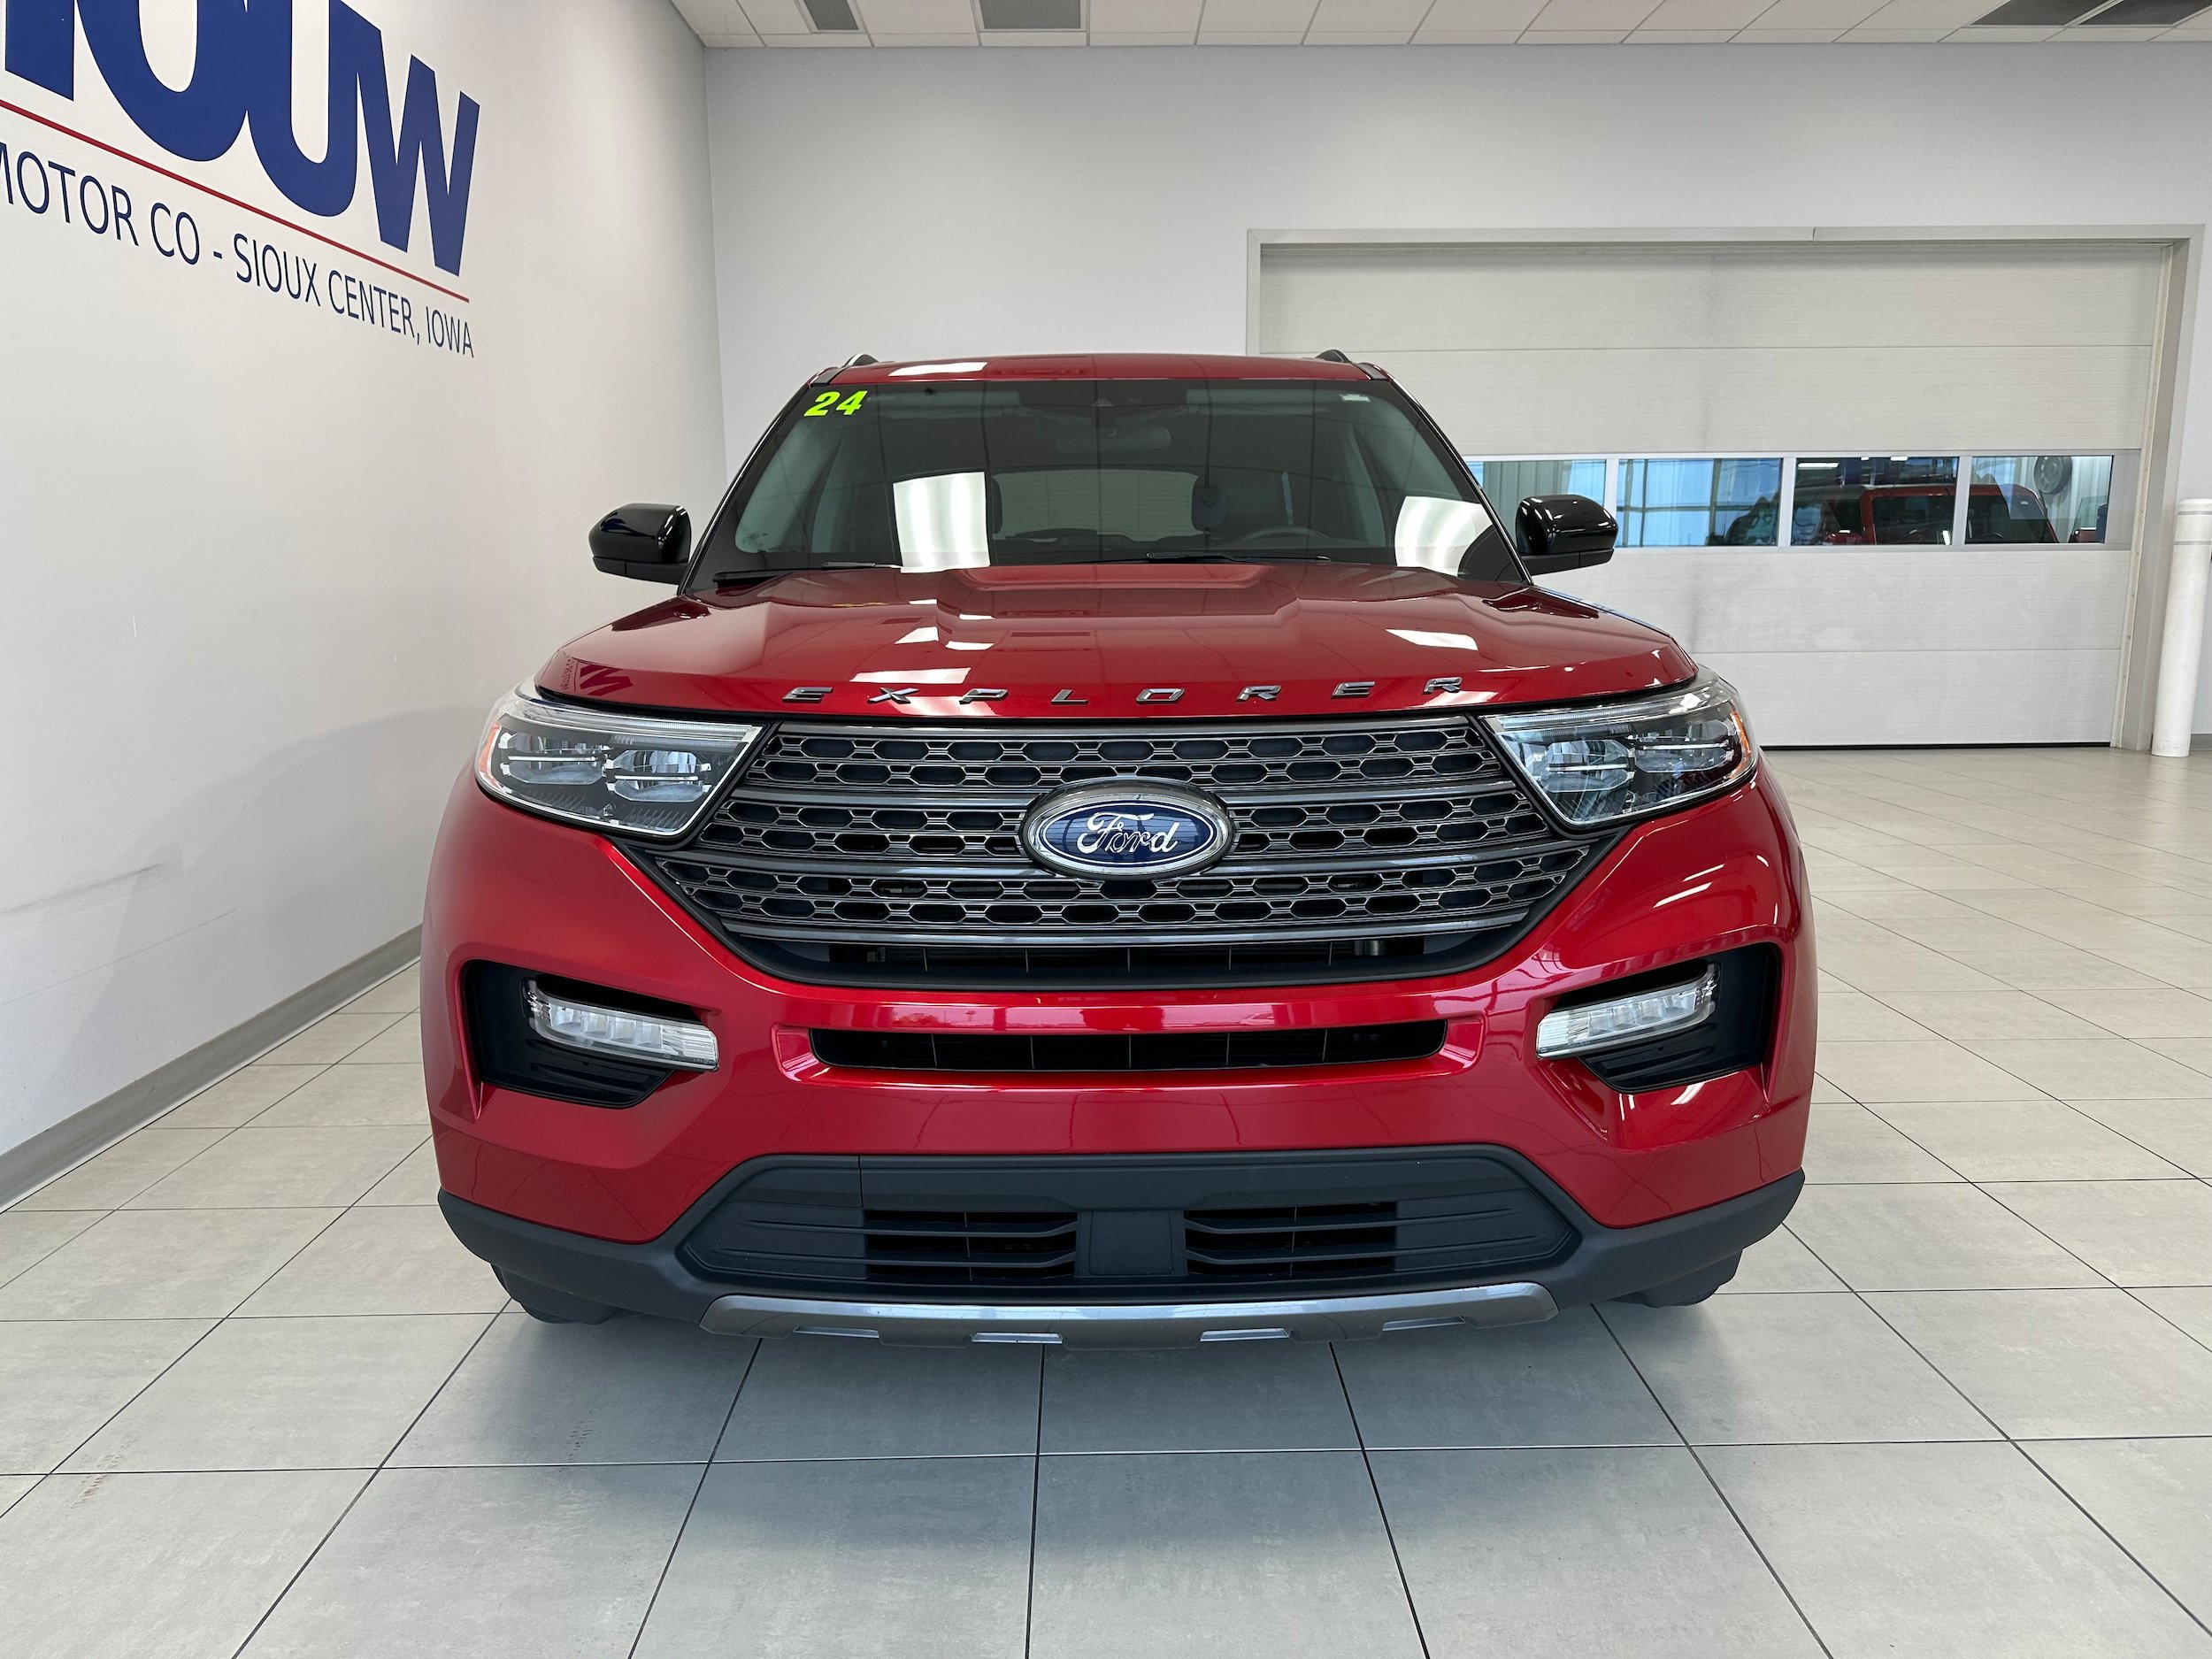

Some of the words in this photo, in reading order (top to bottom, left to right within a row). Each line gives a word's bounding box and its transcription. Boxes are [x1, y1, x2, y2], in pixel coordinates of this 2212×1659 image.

[150, 203, 200, 265] CO
[234, 233, 321, 306] SIOUX
[328, 270, 420, 345] CENTER,
[426, 306, 474, 357] IOWA
[803, 390, 868, 417] 24
[782, 677, 1463, 704] EXPLORER
[1077, 812, 1179, 854] Ford
